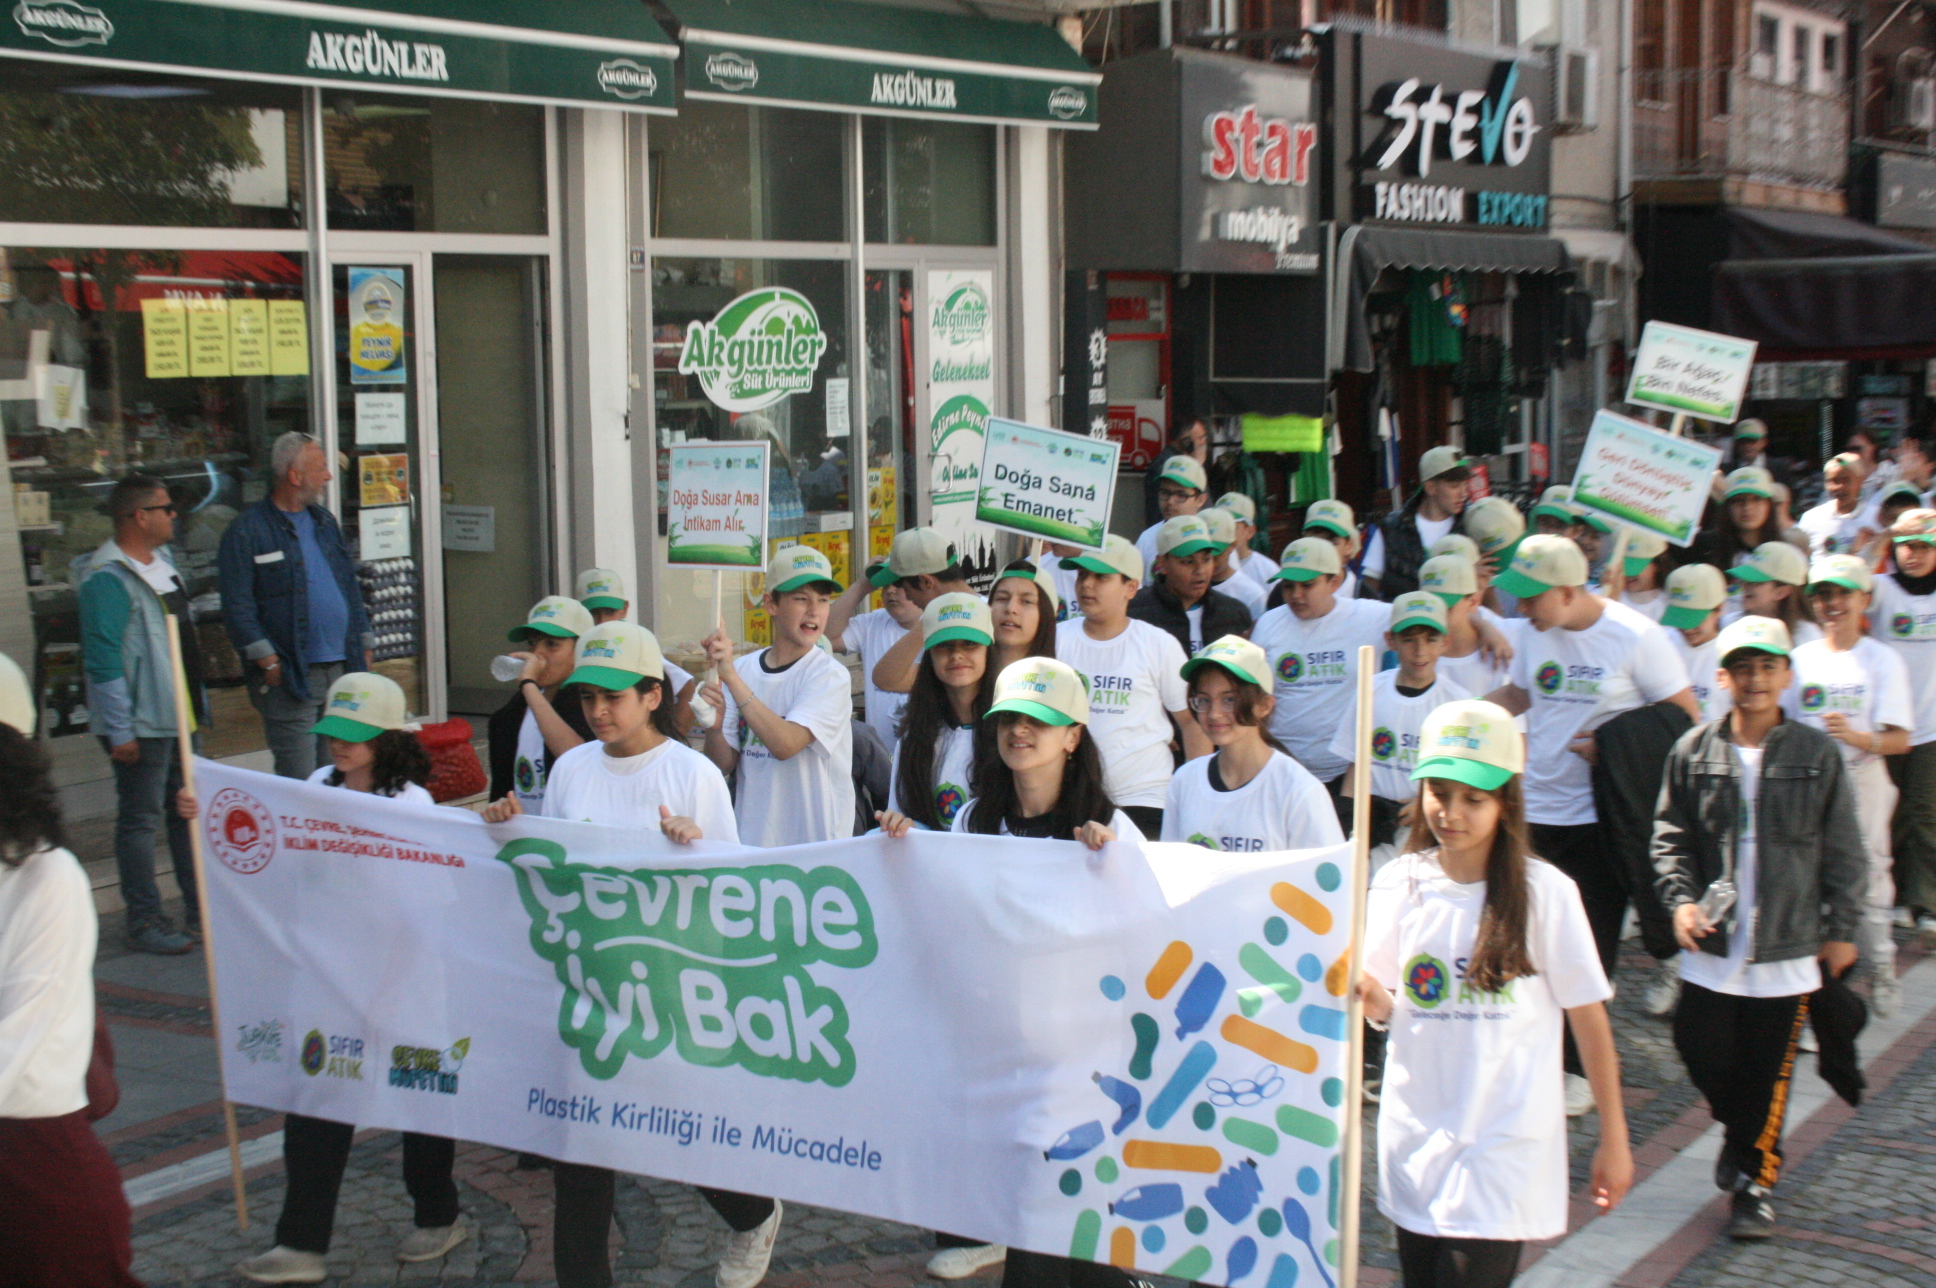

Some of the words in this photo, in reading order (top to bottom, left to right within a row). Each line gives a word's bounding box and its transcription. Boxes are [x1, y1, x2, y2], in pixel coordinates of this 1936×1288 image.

[306, 29, 449, 81] AKGÜNLER
[602, 68, 651, 88] AKGÜNLER
[871, 69, 957, 109] AKGÜNLER
[1210, 104, 1316, 184] star
[1375, 181, 1464, 223] FASHION
[1478, 191, 1546, 227] EXPORT
[682, 323, 826, 379] Akgünler
[743, 371, 763, 389] Süt
[765, 369, 811, 389] Ürünleri
[932, 354, 991, 382] Geleneksel
[932, 409, 960, 449] Edirne
[994, 463, 1043, 490] Doğa
[1049, 476, 1095, 501] Sana
[673, 489, 699, 510] Doğa
[701, 490, 732, 506] Susar
[735, 490, 760, 506] Ama
[1003, 492, 1078, 525] Emanet.
[683, 511, 721, 531] İntikam
[1308, 650, 1346, 664] SIFIR
[1309, 663, 1347, 678] ATIK
[1093, 675, 1132, 691] SIFIR
[1566, 665, 1604, 680] SIFIR
[1091, 690, 1131, 706] ATIK
[284, 834, 319, 850] İKLİM
[396, 847, 466, 868] BAKANLIĞI
[1221, 836, 1264, 852] SIFIR
[511, 853, 863, 950] Çevrene
[679, 967, 842, 1069] Bak
[329, 1035, 364, 1058] SIFIR
[327, 1056, 363, 1081] ATIK
[527, 1087, 602, 1125] Plastik
[612, 1102, 702, 1146] Kirliliği
[712, 1115, 742, 1147] ile
[752, 1124, 883, 1171] Mücadele
